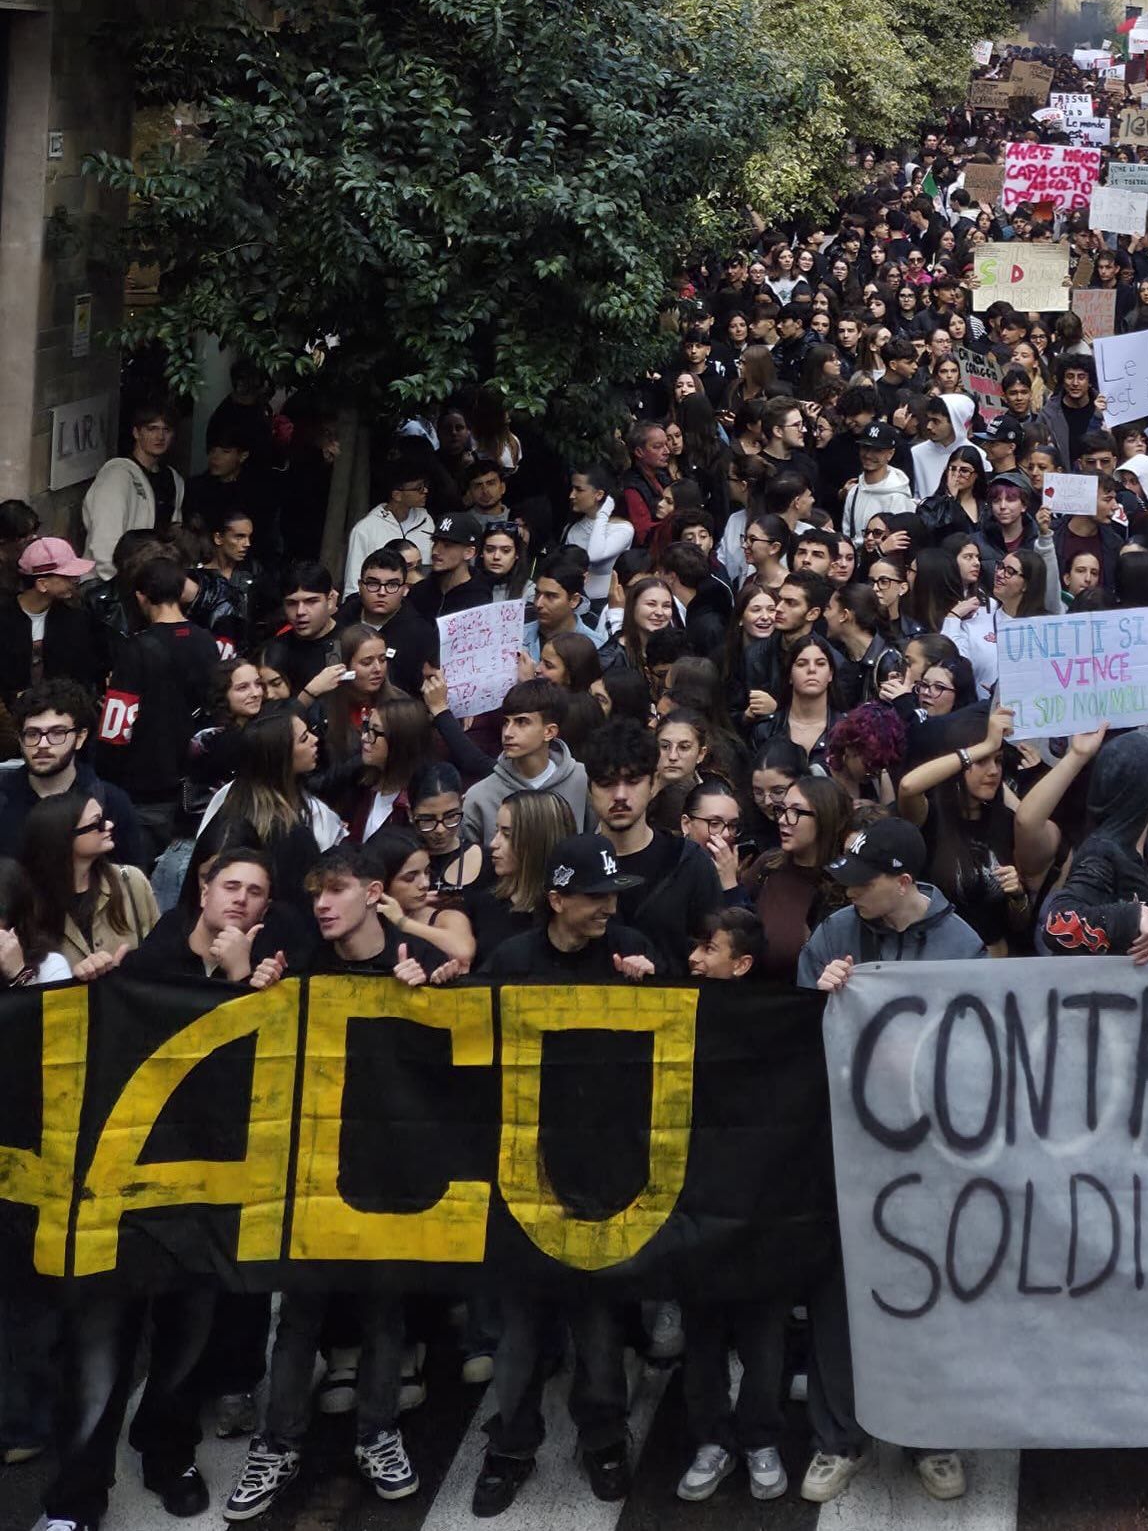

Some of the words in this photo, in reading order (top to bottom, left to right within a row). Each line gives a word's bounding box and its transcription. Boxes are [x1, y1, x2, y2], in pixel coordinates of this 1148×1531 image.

[1006, 142, 1055, 161] AVETE
[1062, 148, 1100, 164] MENO
[1026, 178, 1093, 195] ASCOLTO
[1100, 342, 1137, 383] Le
[1106, 383, 1138, 417] est
[1004, 619, 1109, 663] UNITI
[1118, 616, 1148, 650] SI
[1050, 652, 1132, 690] VINCE
[1032, 692, 1067, 728] SUD
[600, 849, 618, 875] LA
[870, 1171, 1146, 1320] SOLDI
